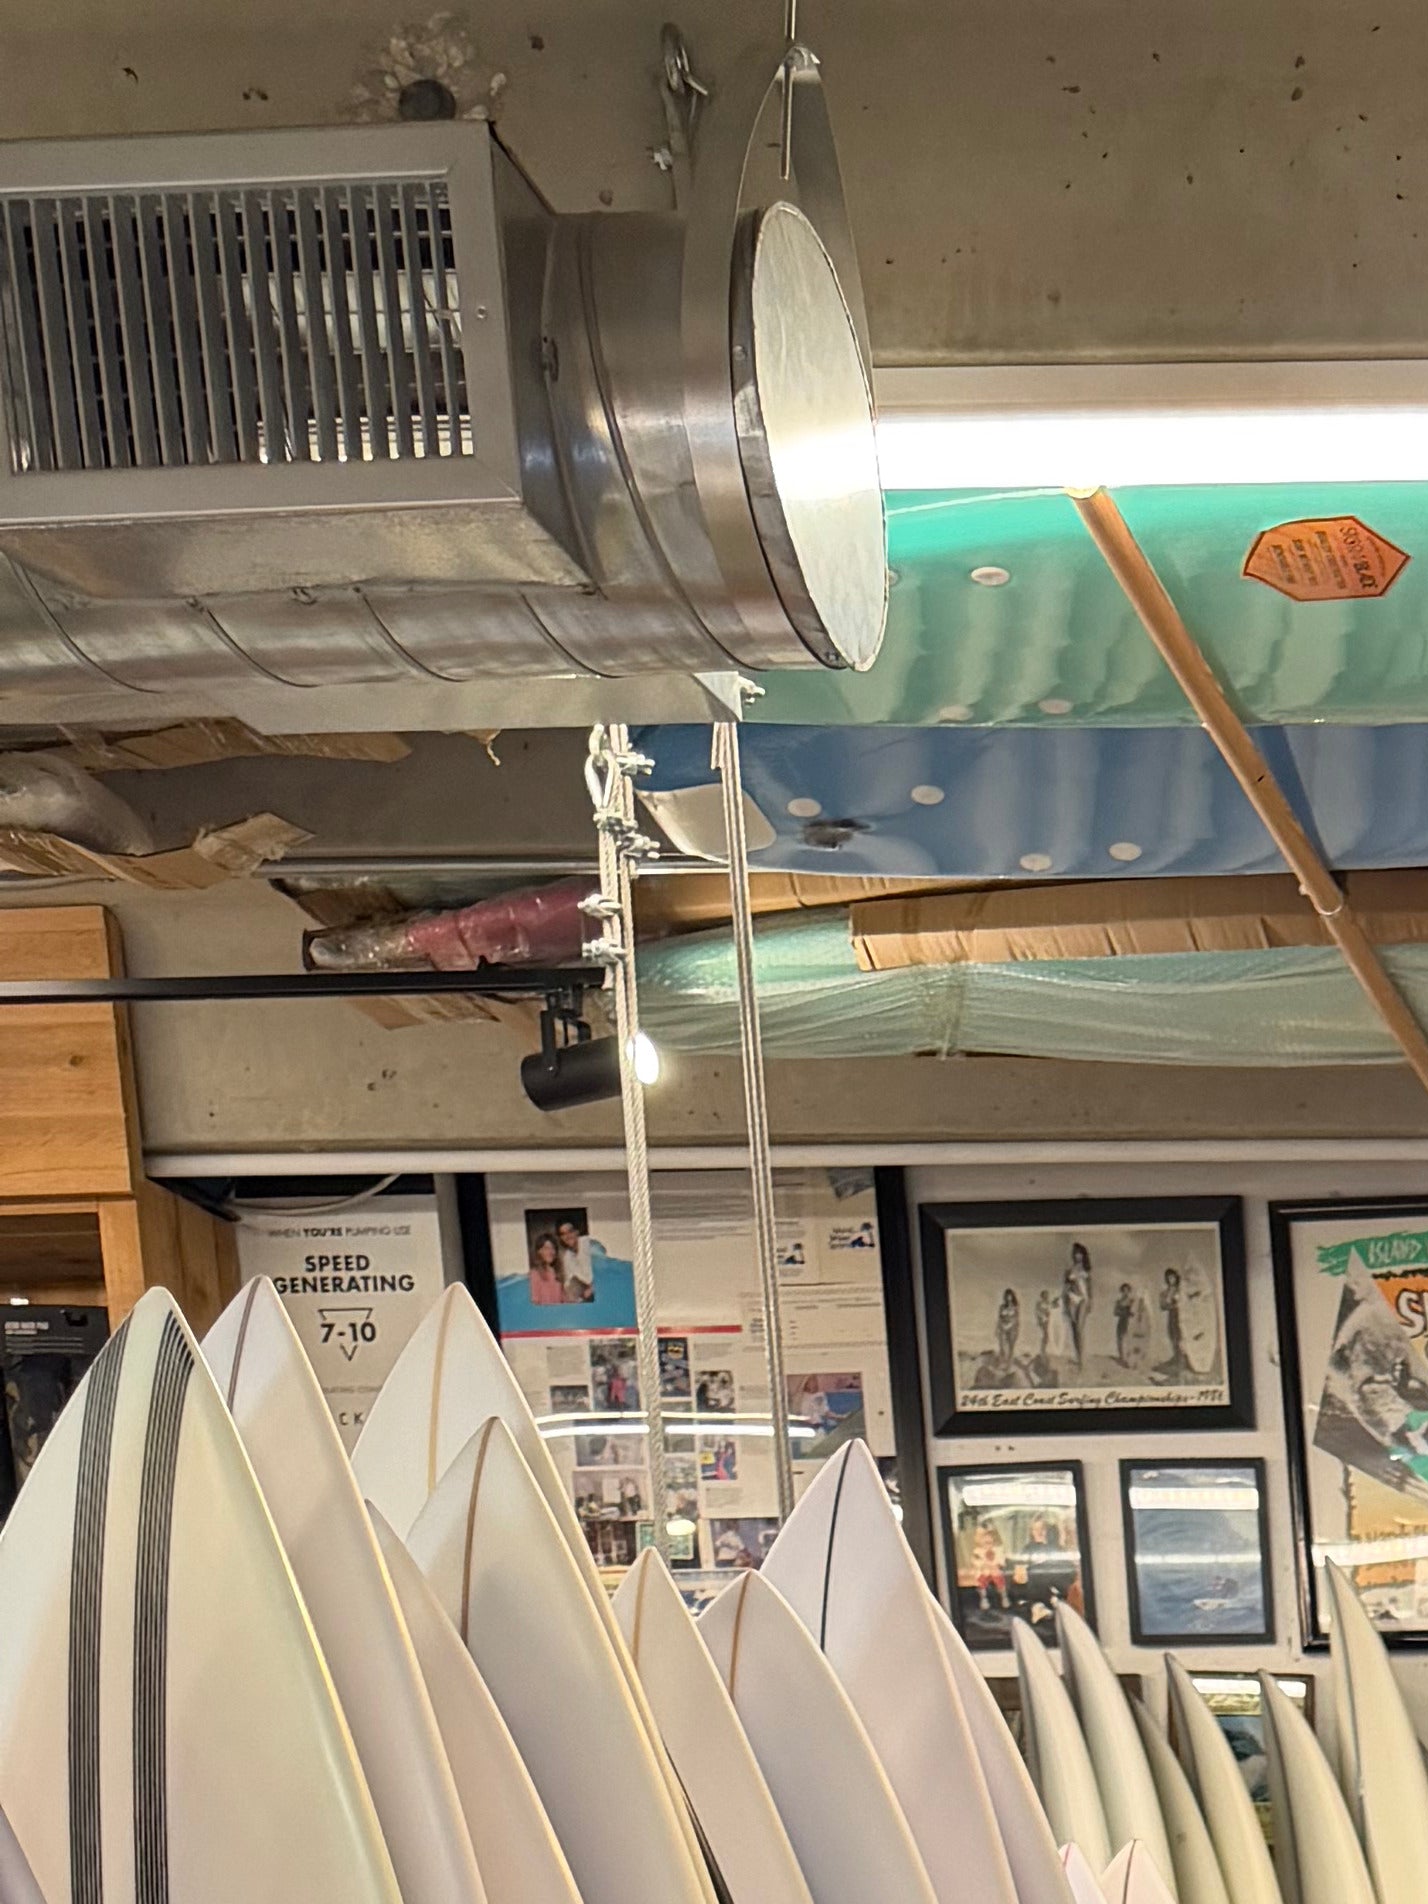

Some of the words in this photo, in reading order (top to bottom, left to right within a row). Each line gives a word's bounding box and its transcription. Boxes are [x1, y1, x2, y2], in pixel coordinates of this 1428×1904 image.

[303, 1227, 343, 1238] YOU'RE
[1367, 1239, 1423, 1264] ISLAND
[305, 1255, 371, 1273] SPEED
[273, 1274, 416, 1294] GENERATING
[320, 1322, 376, 1343] 7-10
